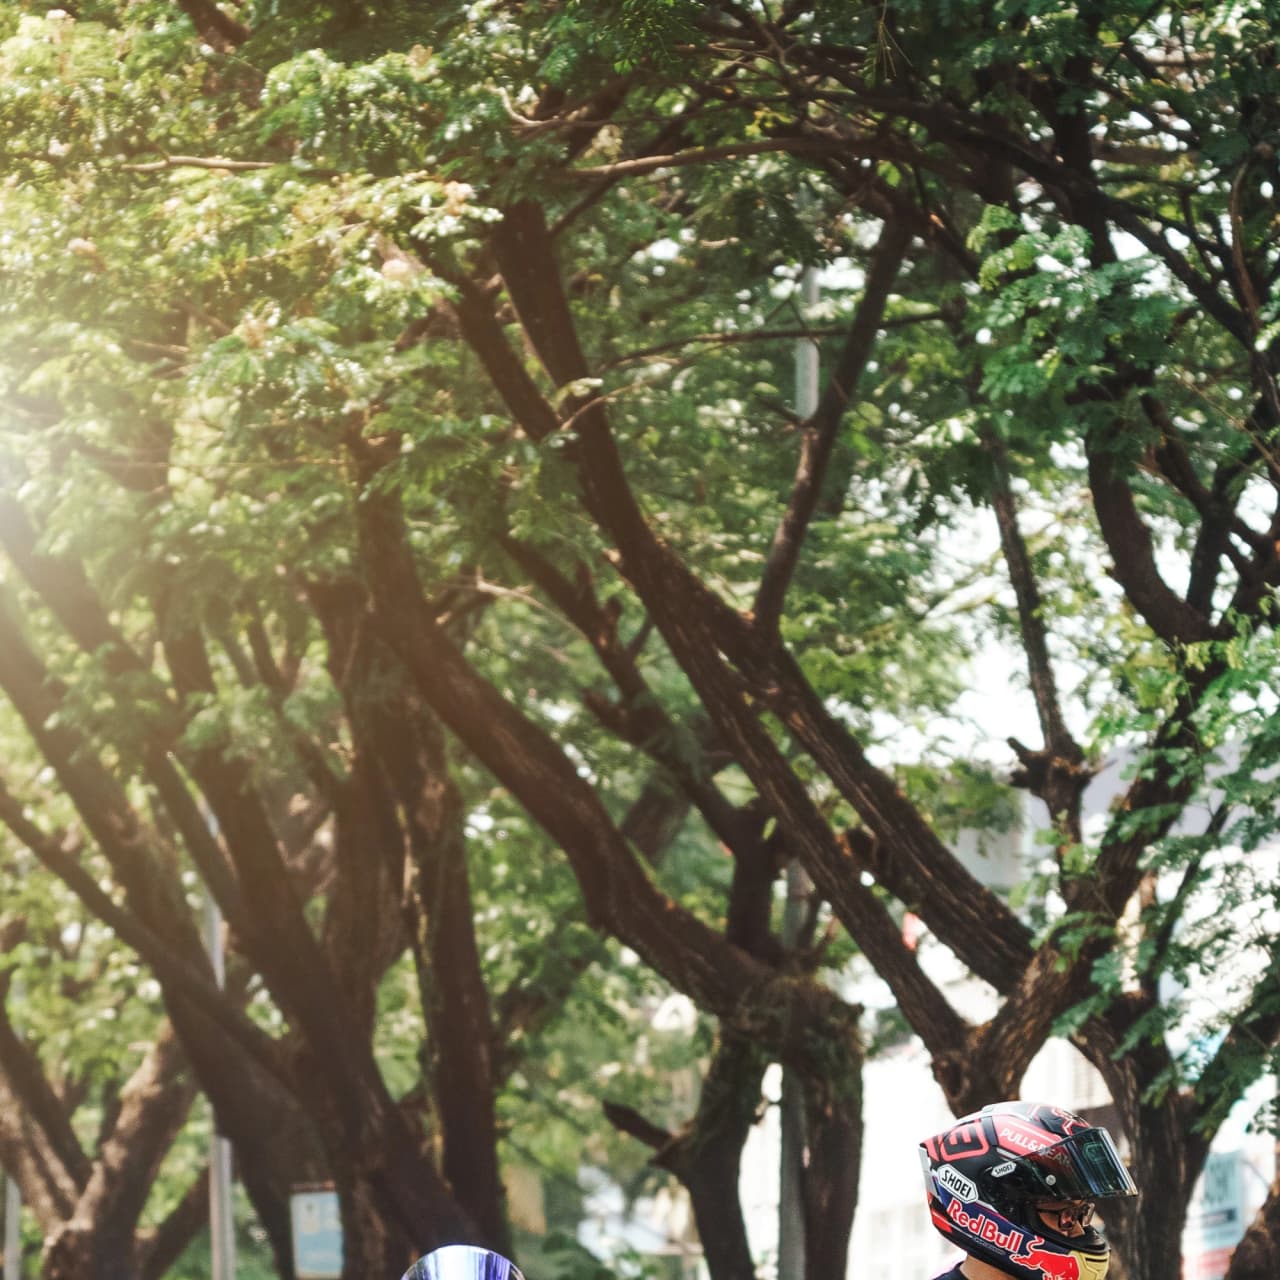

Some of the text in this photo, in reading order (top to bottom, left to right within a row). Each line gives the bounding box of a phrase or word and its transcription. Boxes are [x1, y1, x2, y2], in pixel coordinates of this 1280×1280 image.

[941, 1169, 972, 1199] SHOEI
[994, 1162, 1014, 1176] SHOEI
[947, 1197, 986, 1236] Red
[980, 1218, 1024, 1254] Bull
